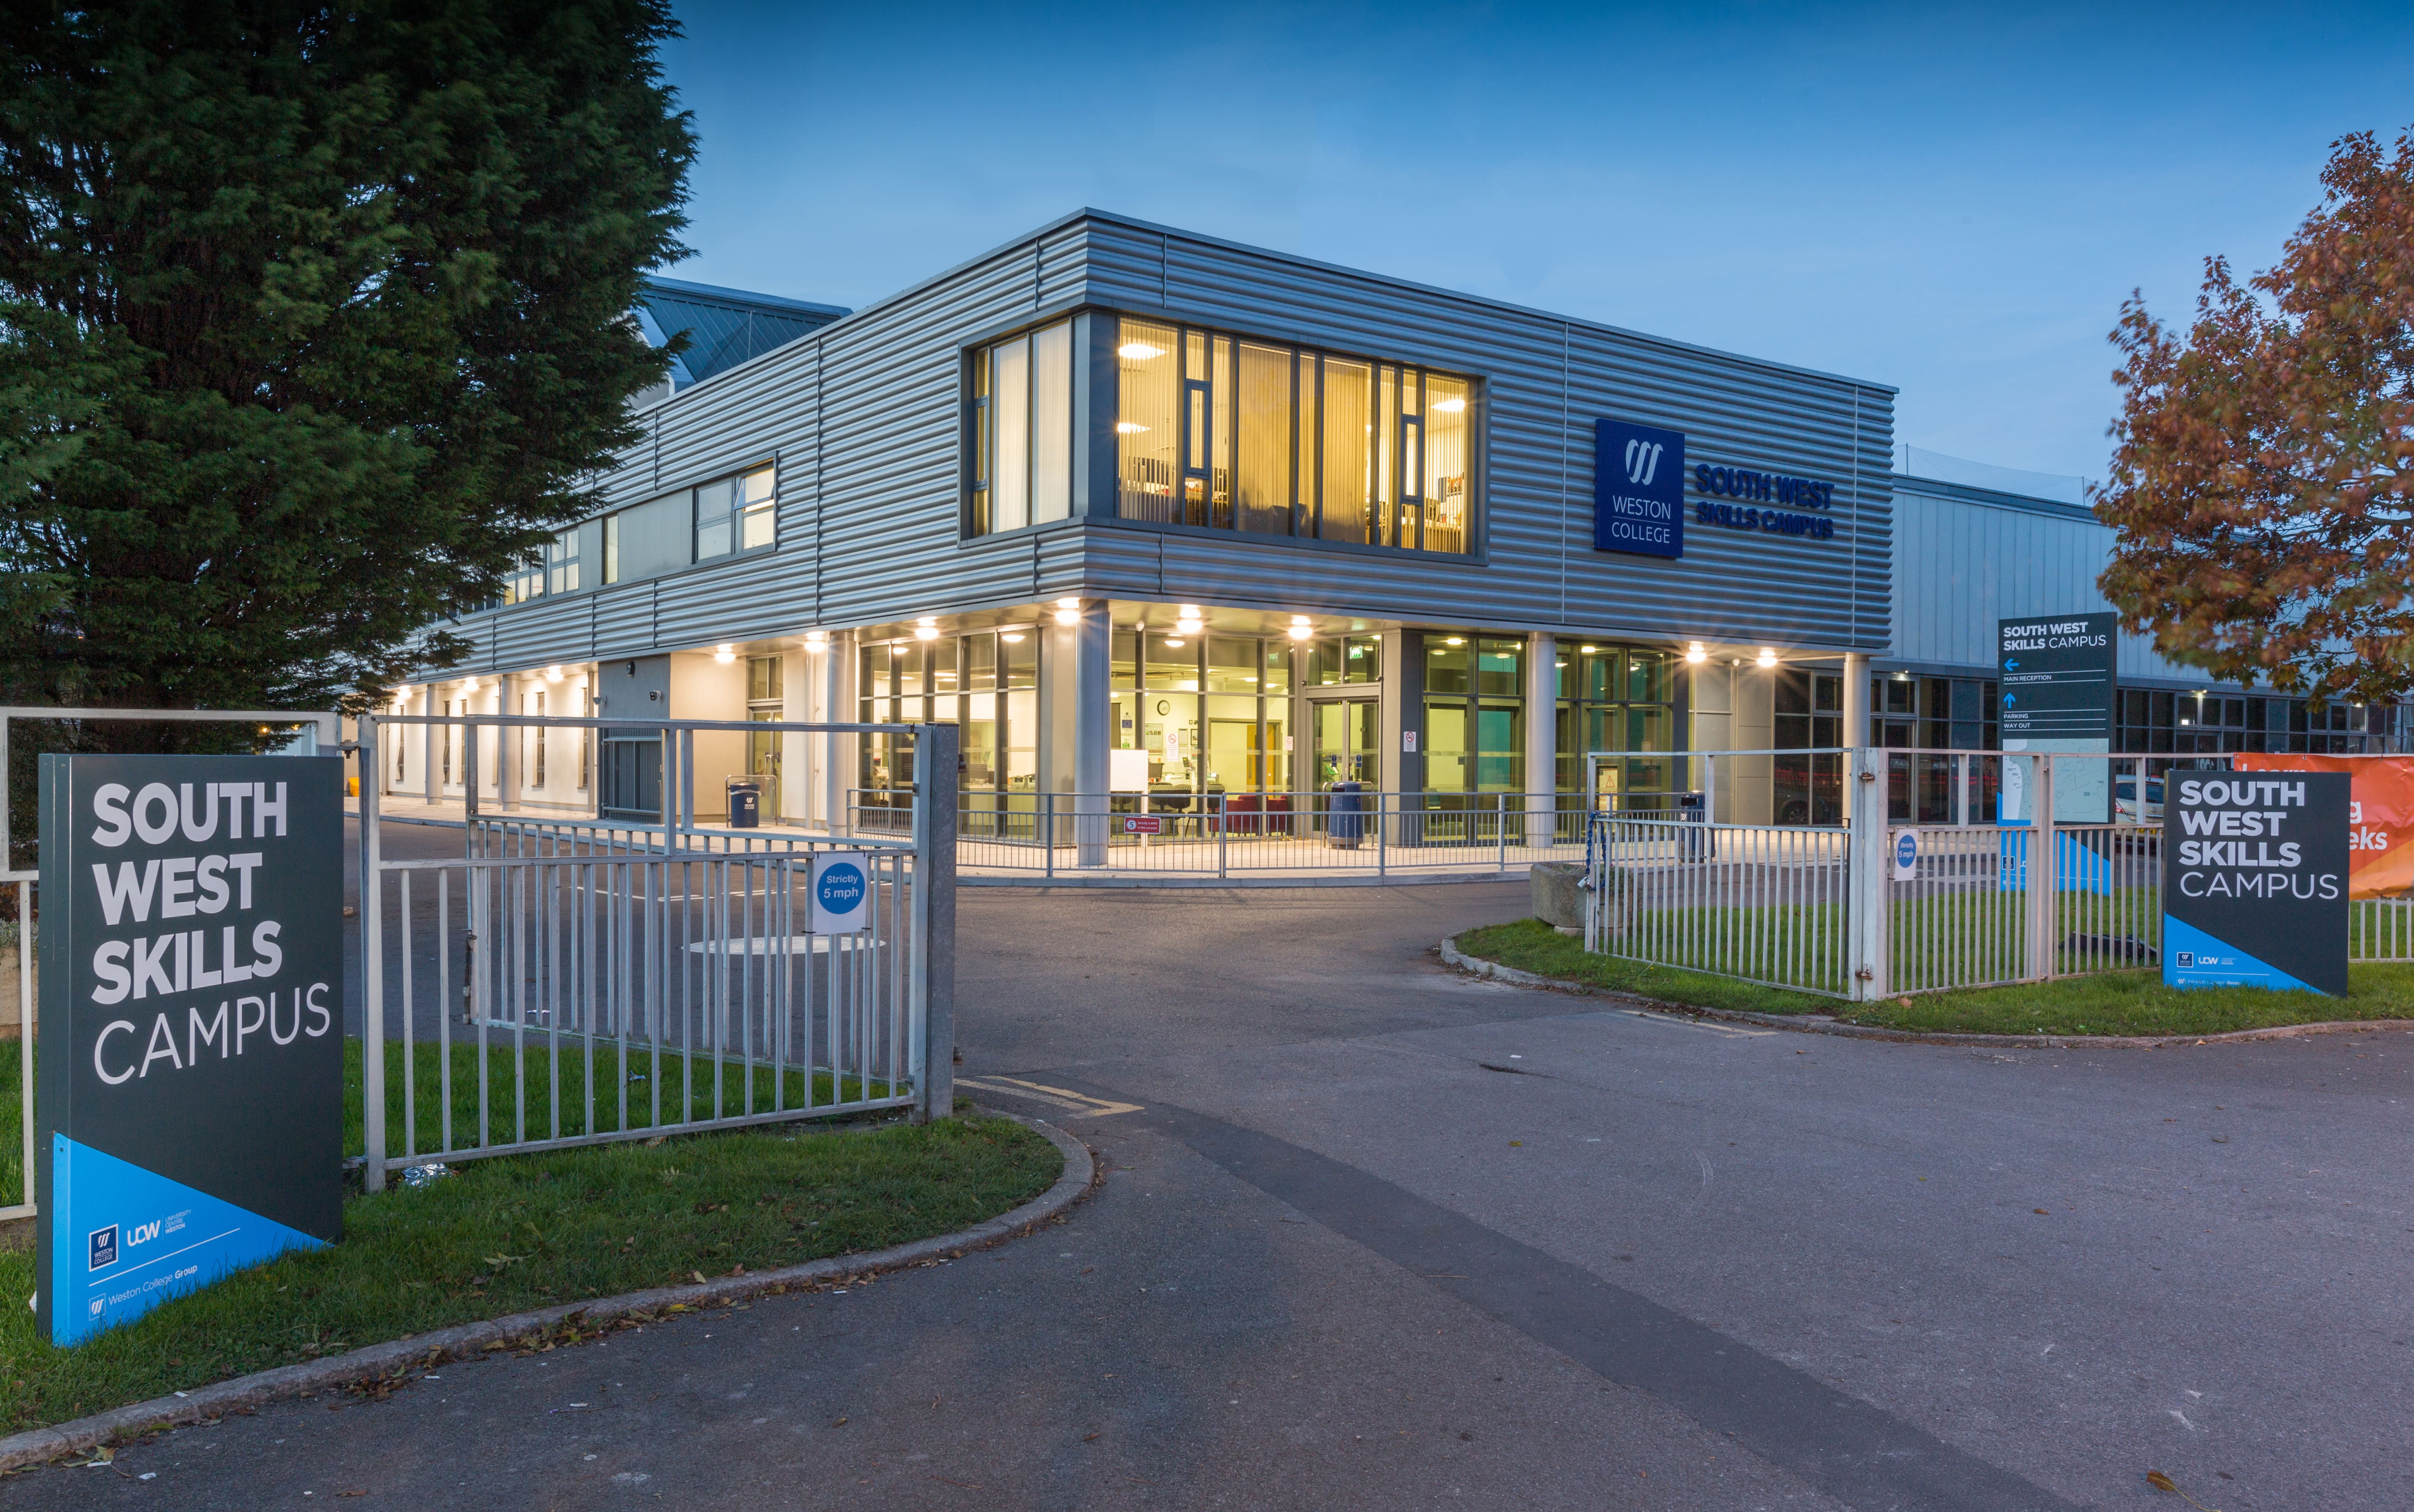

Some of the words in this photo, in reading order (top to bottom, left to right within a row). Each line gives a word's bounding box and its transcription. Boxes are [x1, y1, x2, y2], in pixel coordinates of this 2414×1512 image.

[1695, 463, 1771, 501] SOUTH
[1776, 475, 1835, 509] WEST
[1612, 495, 1671, 520] WESTON
[1696, 501, 1759, 528] SKILLS
[1762, 510, 1834, 538] CAMPUS
[1612, 522, 1670, 543] COLLEGE
[2004, 625, 2047, 638] SOUTH
[2050, 622, 2088, 635] WEST
[2004, 638, 2046, 651] SKILLS
[2048, 635, 2107, 649] CAMPUS
[2179, 780, 2305, 807] SOUTH
[91, 782, 287, 847] SOUTH
[2180, 811, 2286, 836] WEST
[1903, 851, 1914, 859] mph
[2179, 841, 2301, 867] SKILLS
[92, 852, 263, 926] WEST
[826, 875, 858, 884] Strictly
[2180, 872, 2338, 900] CAMPUS
[824, 888, 831, 898] 5
[834, 887, 858, 900] mph
[91, 921, 282, 1005] SKILLS
[2198, 957, 2218, 965] UCW
[94, 983, 330, 1084] CAMPUS
[165, 1209, 192, 1223] UNIVERSITY
[165, 1218, 183, 1228] CENTRE
[165, 1223, 185, 1234] WESTON
[127, 1220, 160, 1246] UCW
[94, 1247, 113, 1258] WESTON
[94, 1254, 113, 1265] COLLEGE
[108, 1287, 141, 1305] Weston
[143, 1274, 173, 1292] College
[175, 1265, 198, 1279] Group
